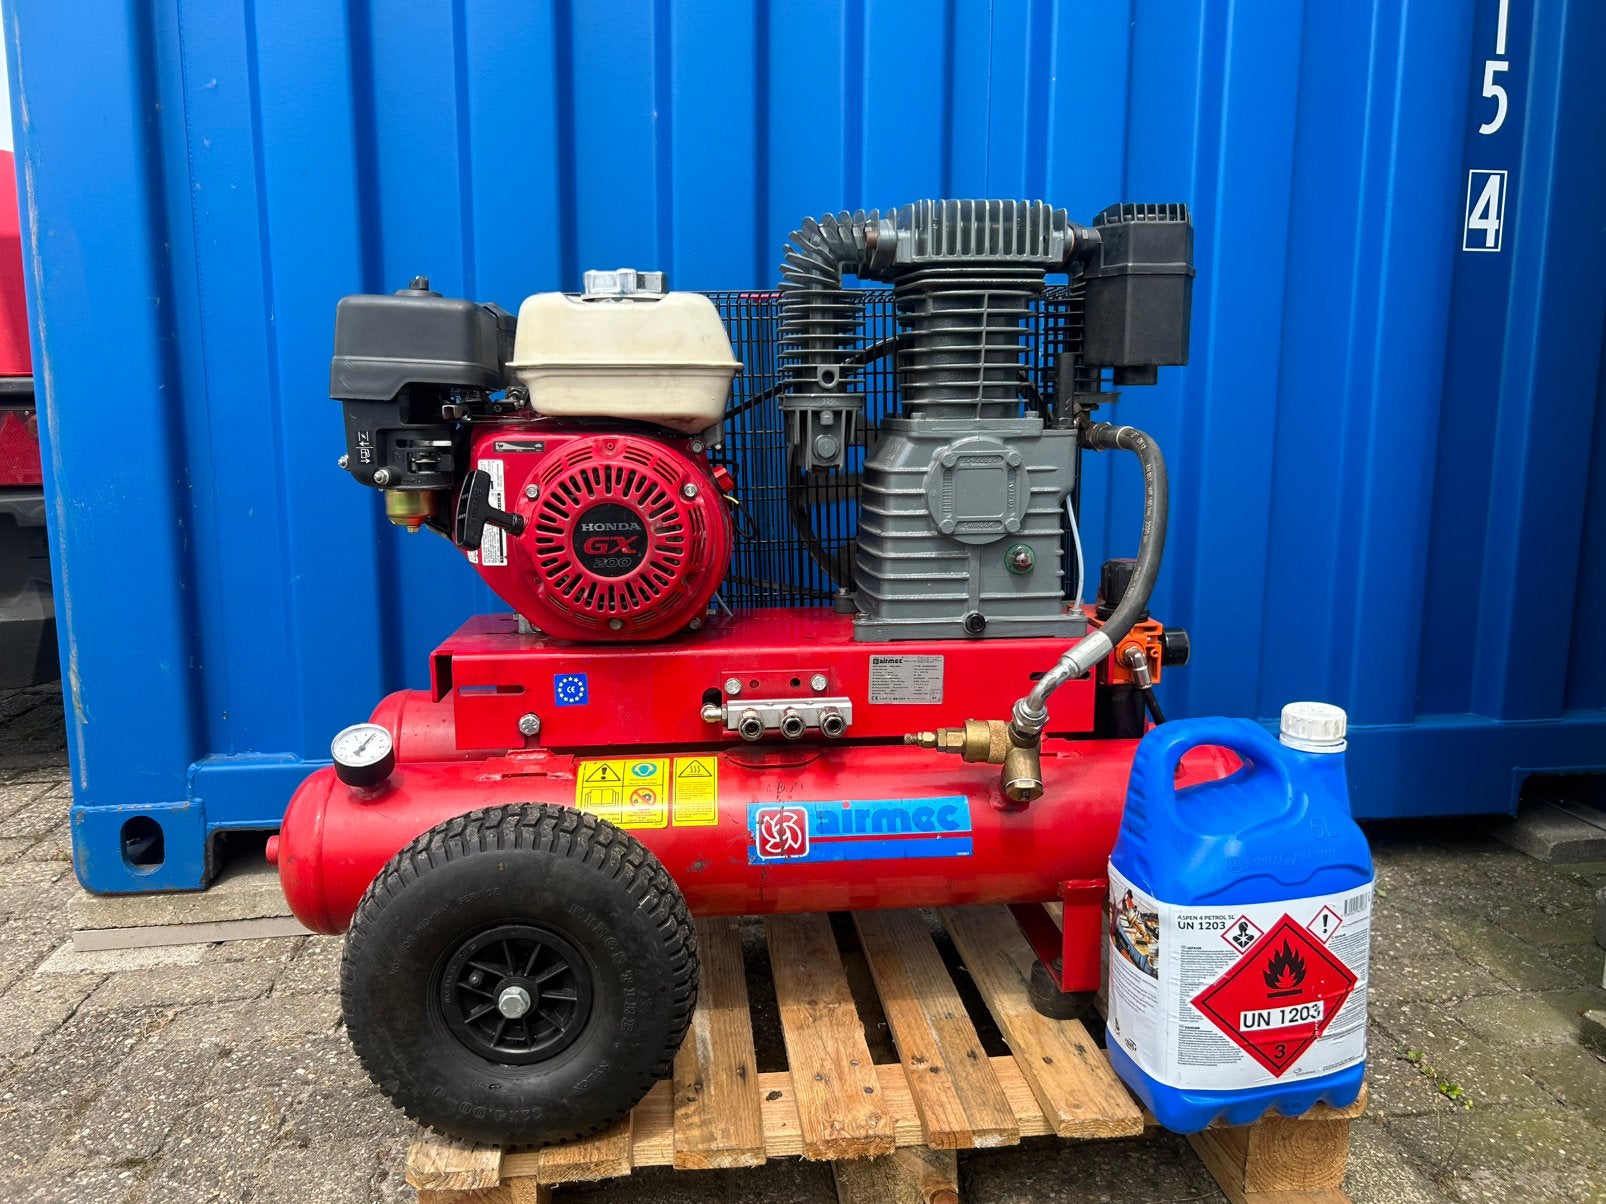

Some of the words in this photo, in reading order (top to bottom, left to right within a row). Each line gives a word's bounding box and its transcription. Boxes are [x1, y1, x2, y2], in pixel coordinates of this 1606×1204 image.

[1467, 173, 1502, 248] 4
[580, 522, 642, 532] HONDA
[583, 536, 640, 556] GX
[592, 557, 632, 568] 200
[815, 800, 961, 835] airmec
[1177, 921, 1194, 930] UN
[1198, 921, 1226, 930] 1203
[1243, 1011, 1271, 1029] UN
[1279, 1003, 1321, 1025] 1203
[1274, 1043, 1286, 1060] 3
